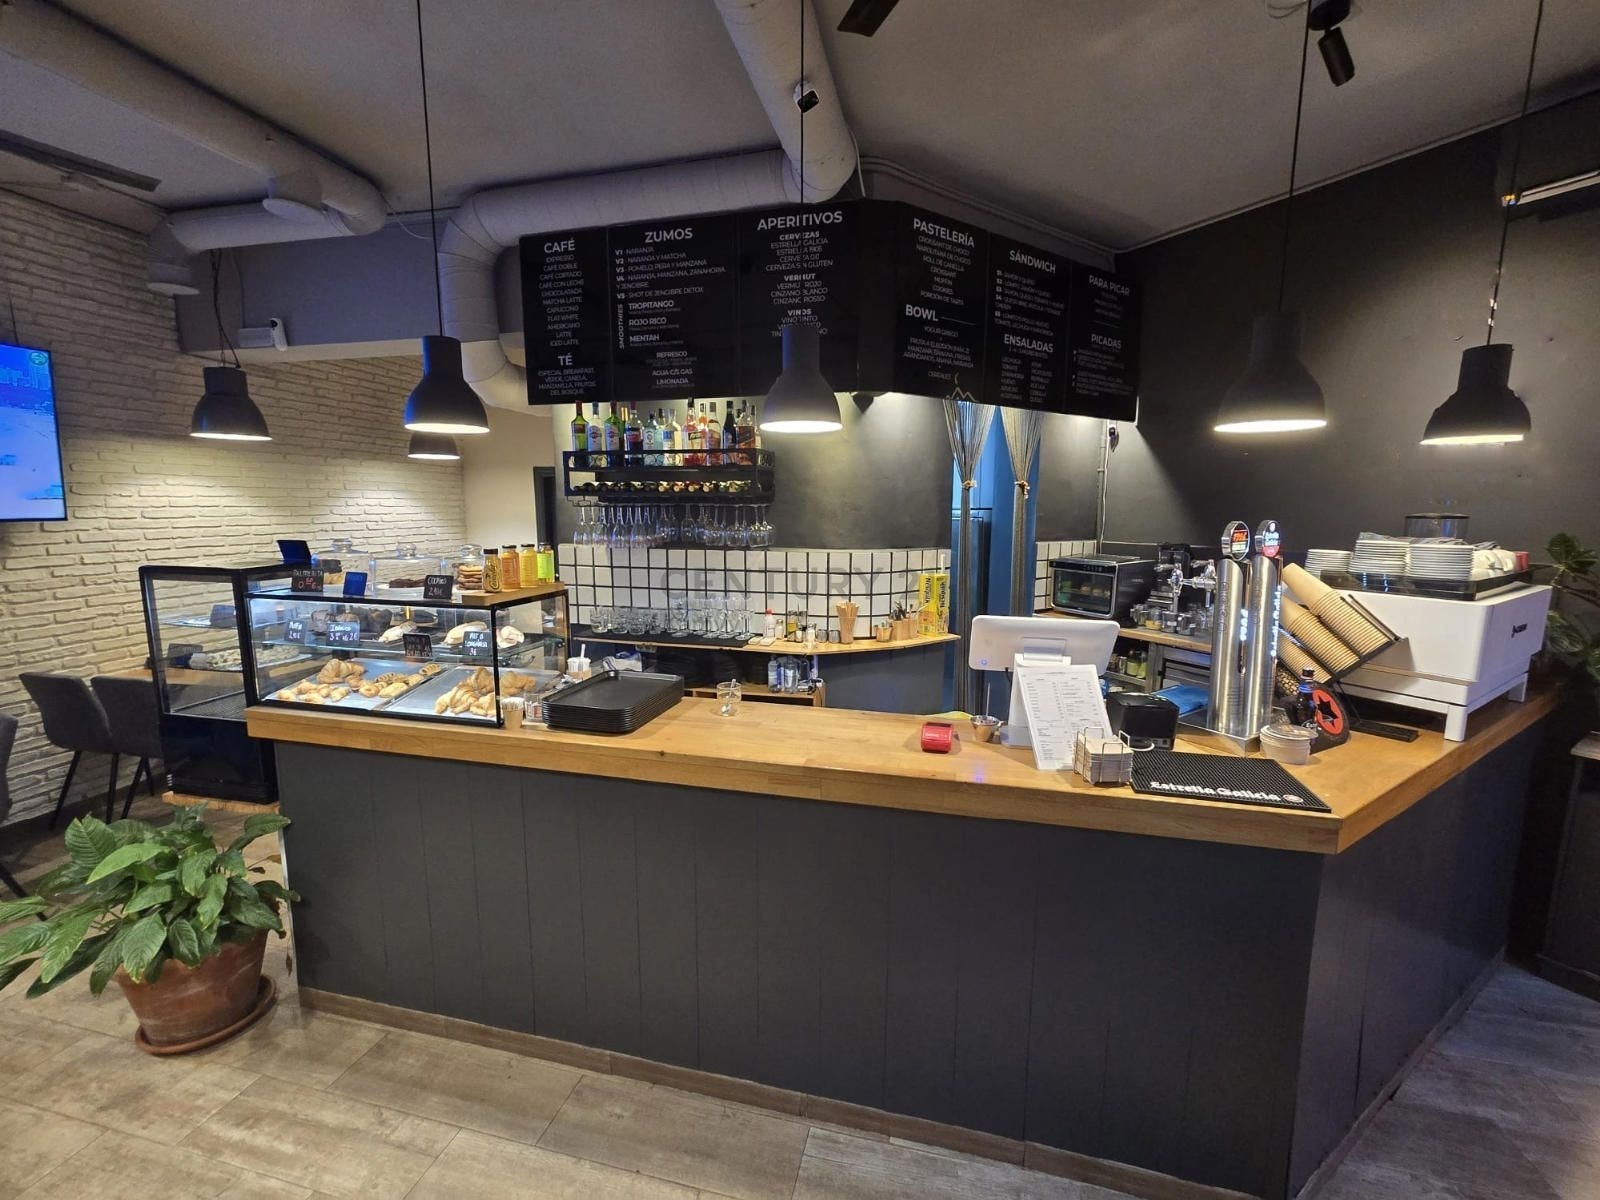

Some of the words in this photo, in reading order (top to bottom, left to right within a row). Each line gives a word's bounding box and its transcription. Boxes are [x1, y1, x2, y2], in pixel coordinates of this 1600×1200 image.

[757, 211, 843, 231] APERITIVOS
[644, 227, 693, 243] ZUMOS
[913, 217, 975, 248] PASTELERÍA
[544, 238, 576, 254] CAFÉ
[661, 252, 687, 260] MATCHA
[676, 259, 707, 268] MANZANA
[1009, 248, 1056, 274] SÁNDWICH
[628, 299, 675, 311] TROPITANGO
[905, 303, 939, 322] BOWL
[617, 303, 625, 350] SMOOTHIES
[629, 318, 649, 327] ROJO
[649, 316, 667, 325] RICO
[1004, 333, 1053, 353] ENSALADAS
[1091, 333, 1122, 349] PICADAS
[557, 352, 573, 366] TÉ
[652, 369, 670, 377] AGUA
[680, 367, 693, 375] GAS
[656, 377, 689, 385] LIMONADA
[1150, 781, 1216, 795] Estrella
[1216, 787, 1281, 801] Galicia
